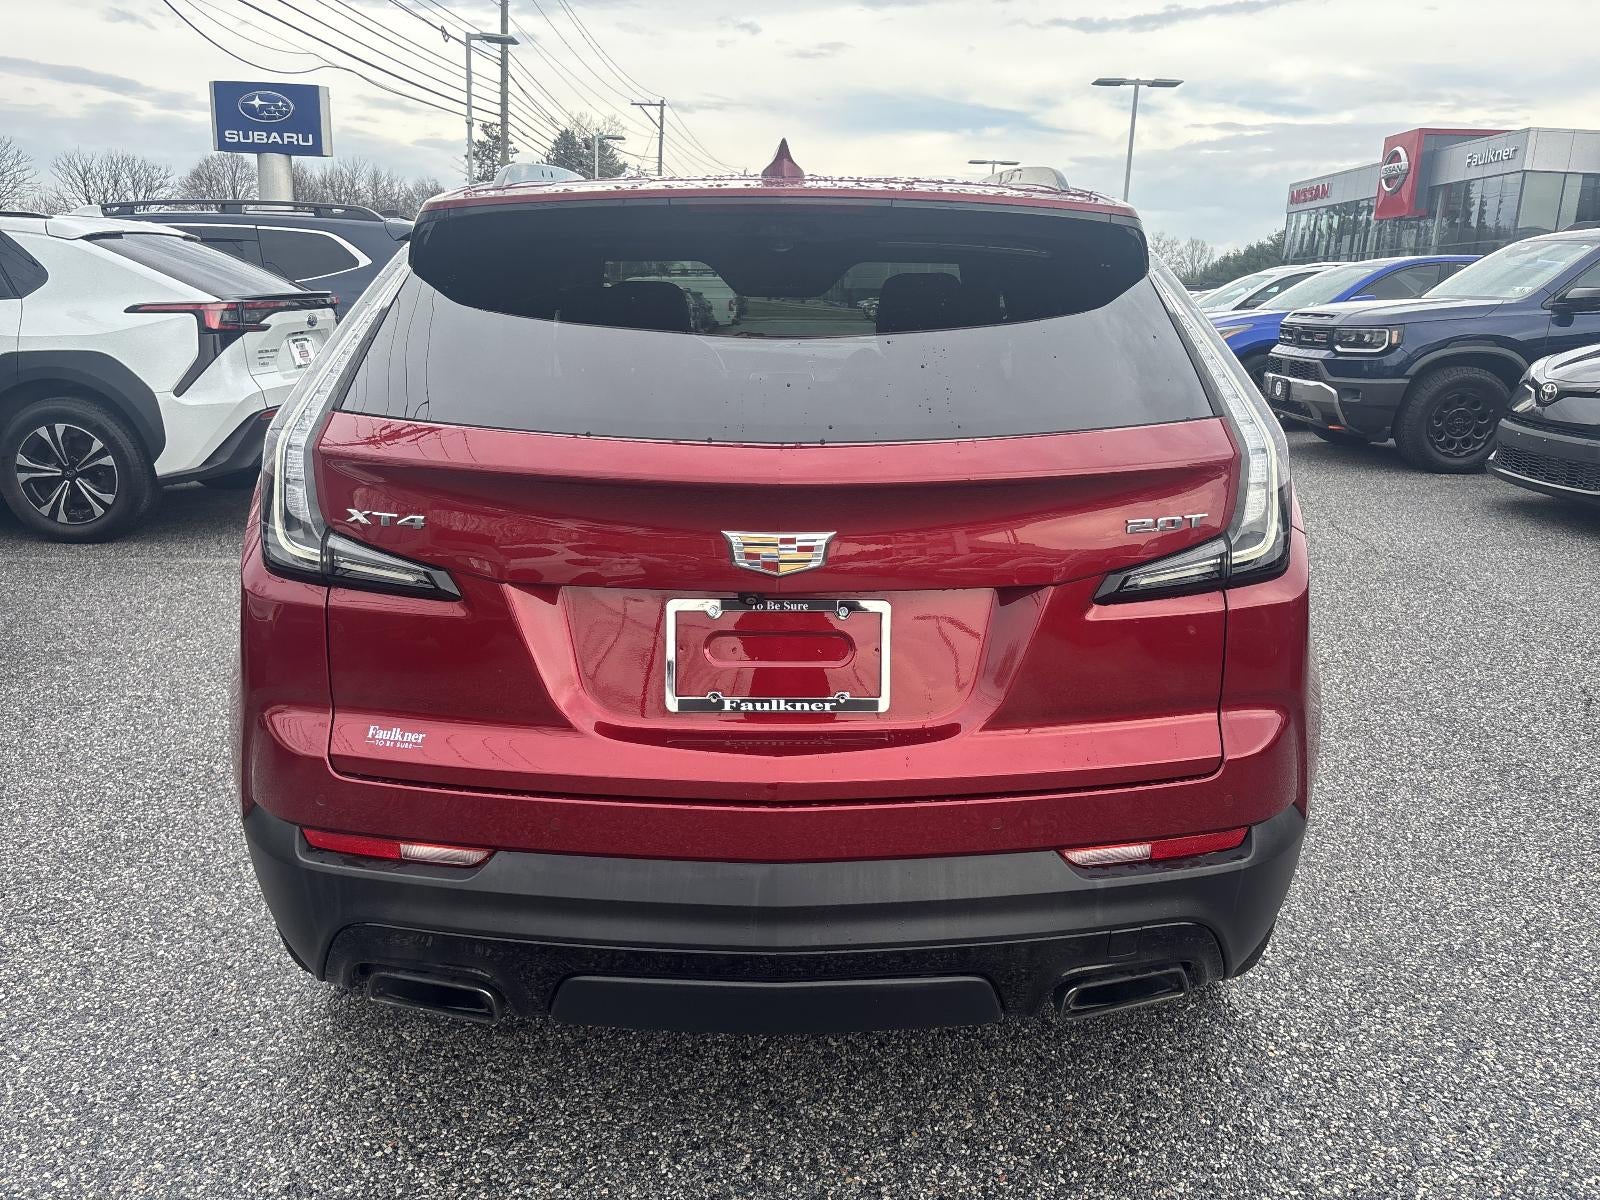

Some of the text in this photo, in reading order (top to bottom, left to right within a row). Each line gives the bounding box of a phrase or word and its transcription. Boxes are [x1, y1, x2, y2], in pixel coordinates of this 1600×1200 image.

[224, 129, 313, 146] SUBARU
[1465, 146, 1516, 167] Faulkner
[1290, 183, 1331, 204] NISSAN
[346, 508, 425, 529] XT4
[1125, 513, 1209, 534] 2.0T
[767, 600, 780, 610] Be
[783, 600, 809, 610] Sure
[721, 699, 837, 711] Faulkner
[367, 725, 426, 743] Faulkner
